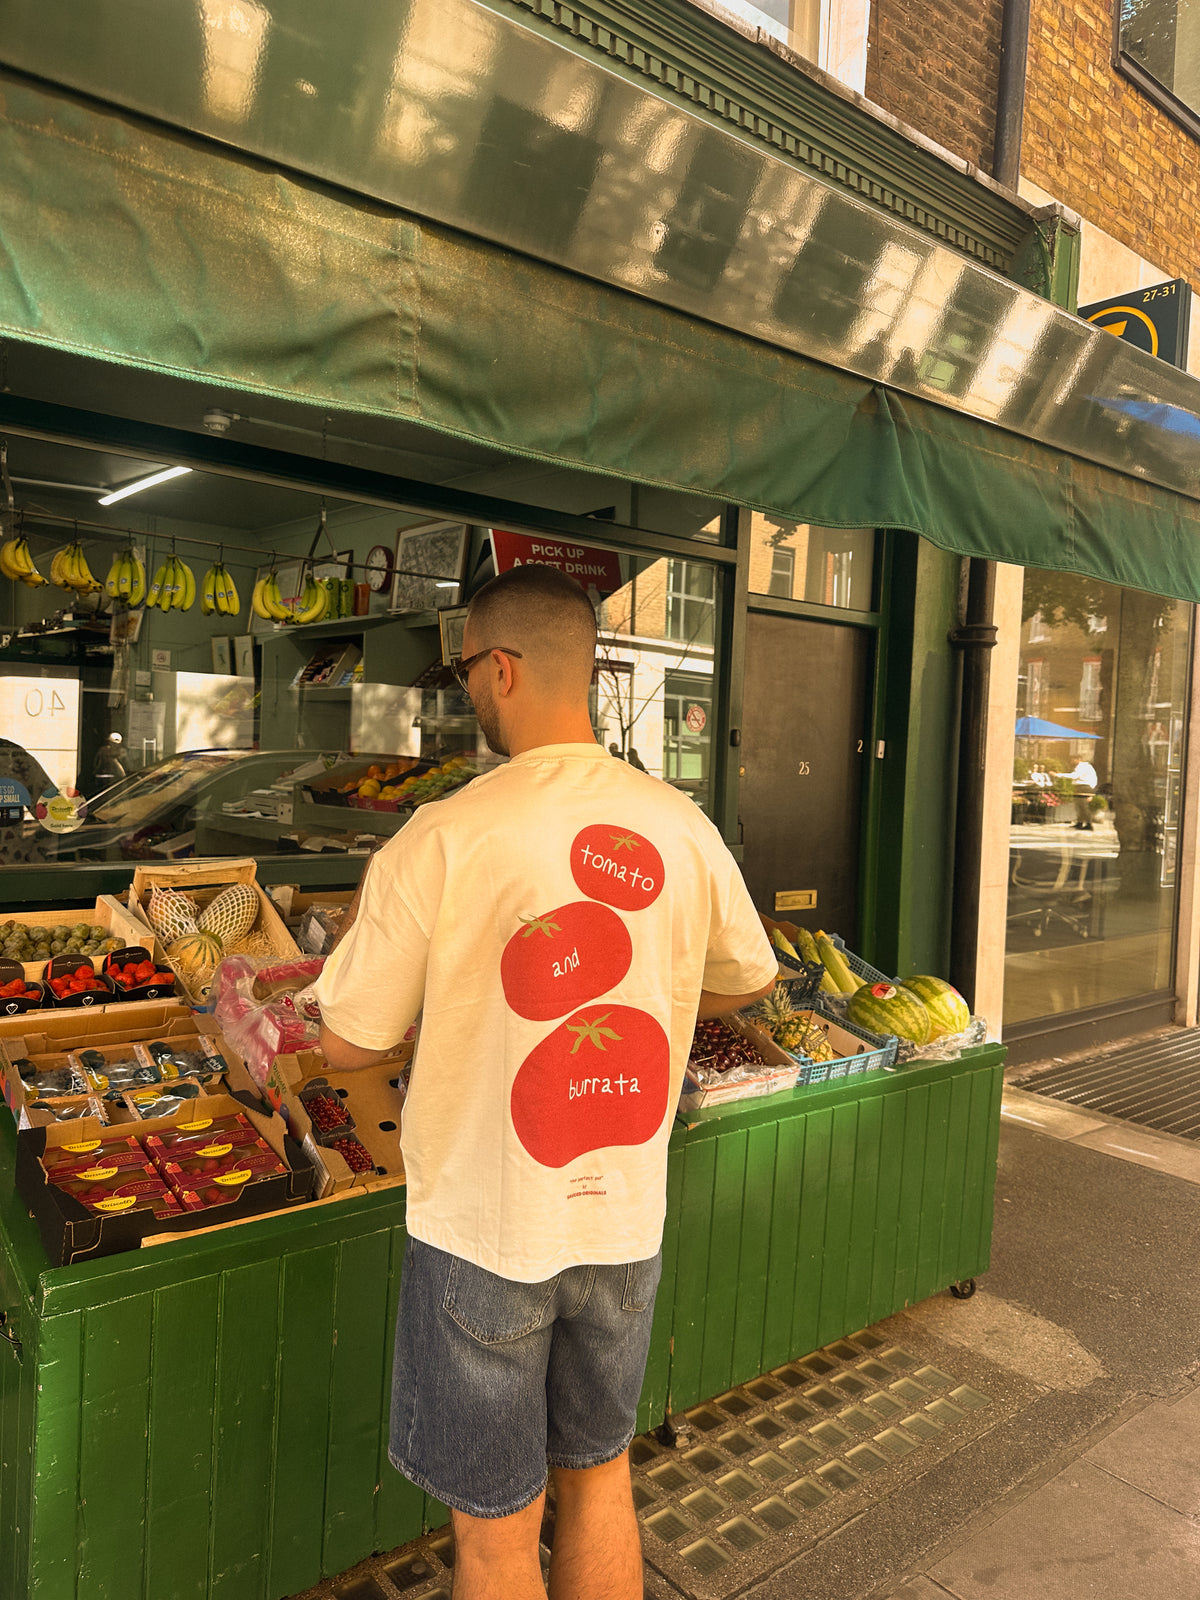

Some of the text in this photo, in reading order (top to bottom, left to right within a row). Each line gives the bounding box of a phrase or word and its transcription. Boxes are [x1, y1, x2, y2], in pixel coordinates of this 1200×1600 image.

[1142, 284, 1176, 303] 27-31
[531, 544, 585, 559] PICK UP
[513, 557, 523, 568] A
[565, 562, 607, 576] DRINK
[799, 761, 810, 775] 25
[580, 844, 654, 891] tomato
[552, 947, 580, 977] and
[568, 1073, 641, 1100] burrata
